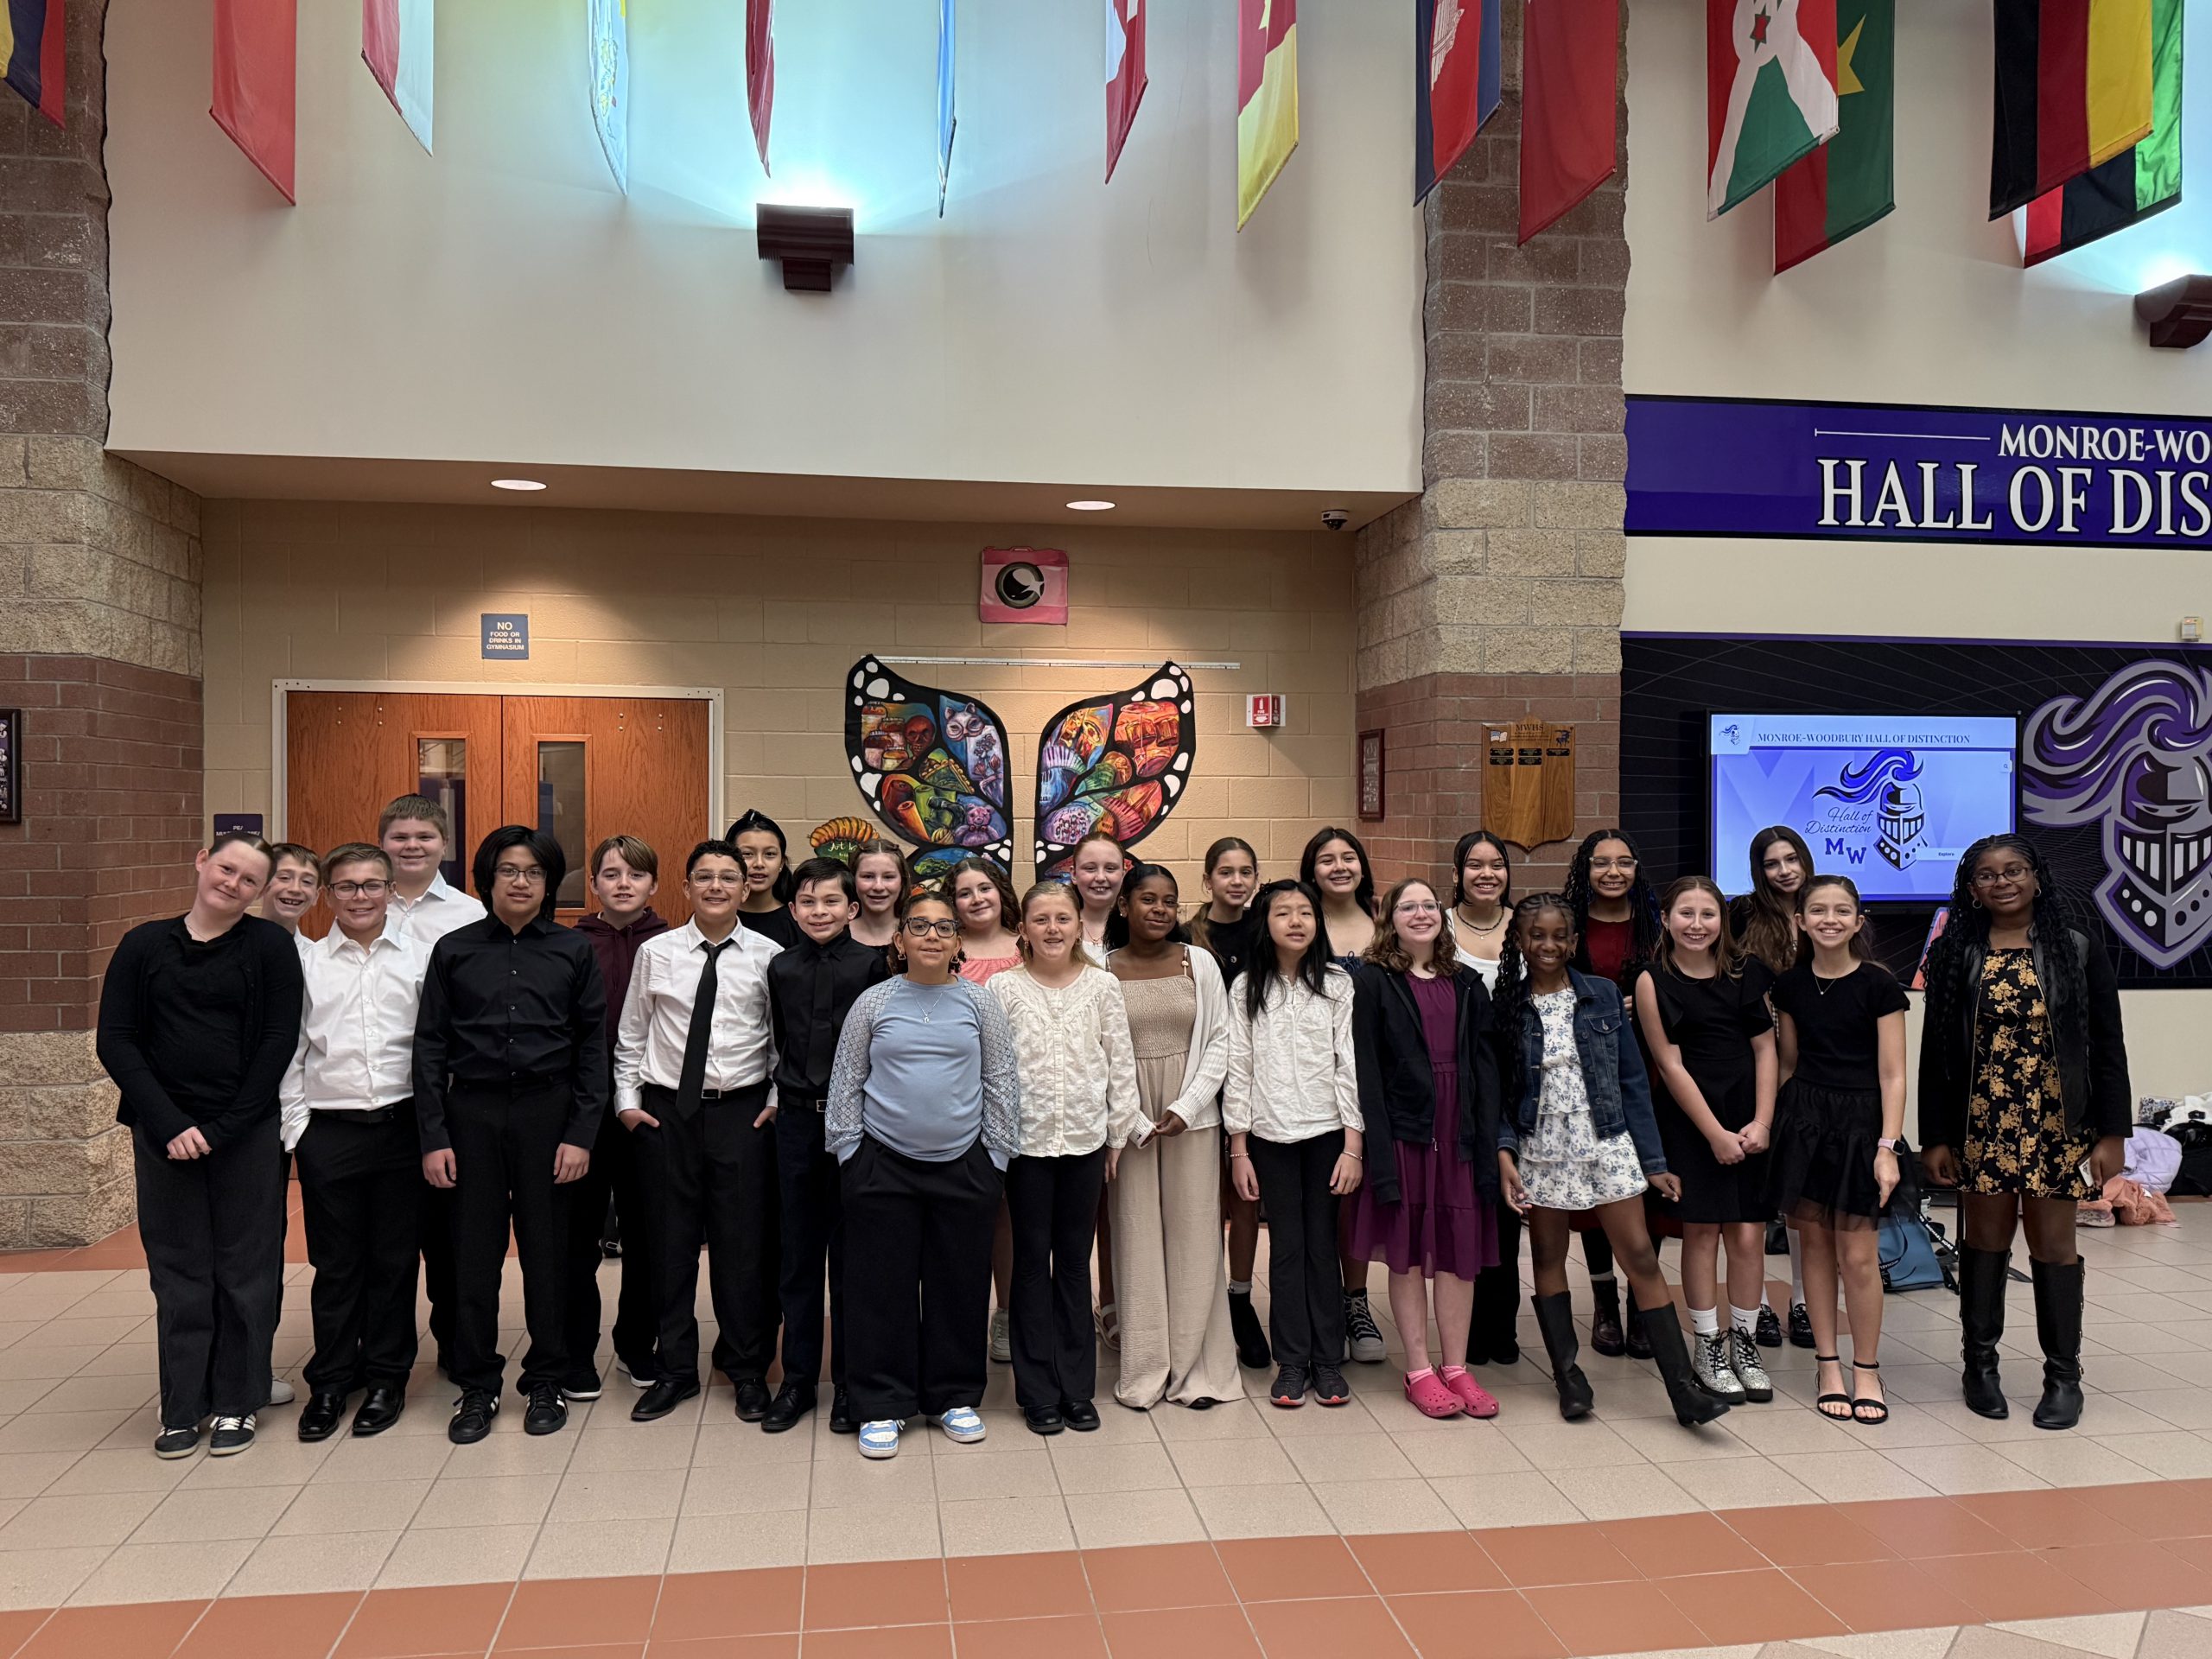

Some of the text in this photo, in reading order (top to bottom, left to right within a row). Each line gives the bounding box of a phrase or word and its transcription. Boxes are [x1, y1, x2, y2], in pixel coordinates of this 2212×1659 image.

[1998, 423, 2211, 464] MONROE-WO
[1817, 459, 2212, 537] HALL OF DIS
[497, 621, 513, 631] NO
[1516, 723, 1544, 732] MWHS
[1758, 733, 1971, 744] MONROE-WOODBURY HALL OF DISTINCTION
[1827, 806, 1874, 824] Hall of
[1804, 820, 1872, 835] Distinction
